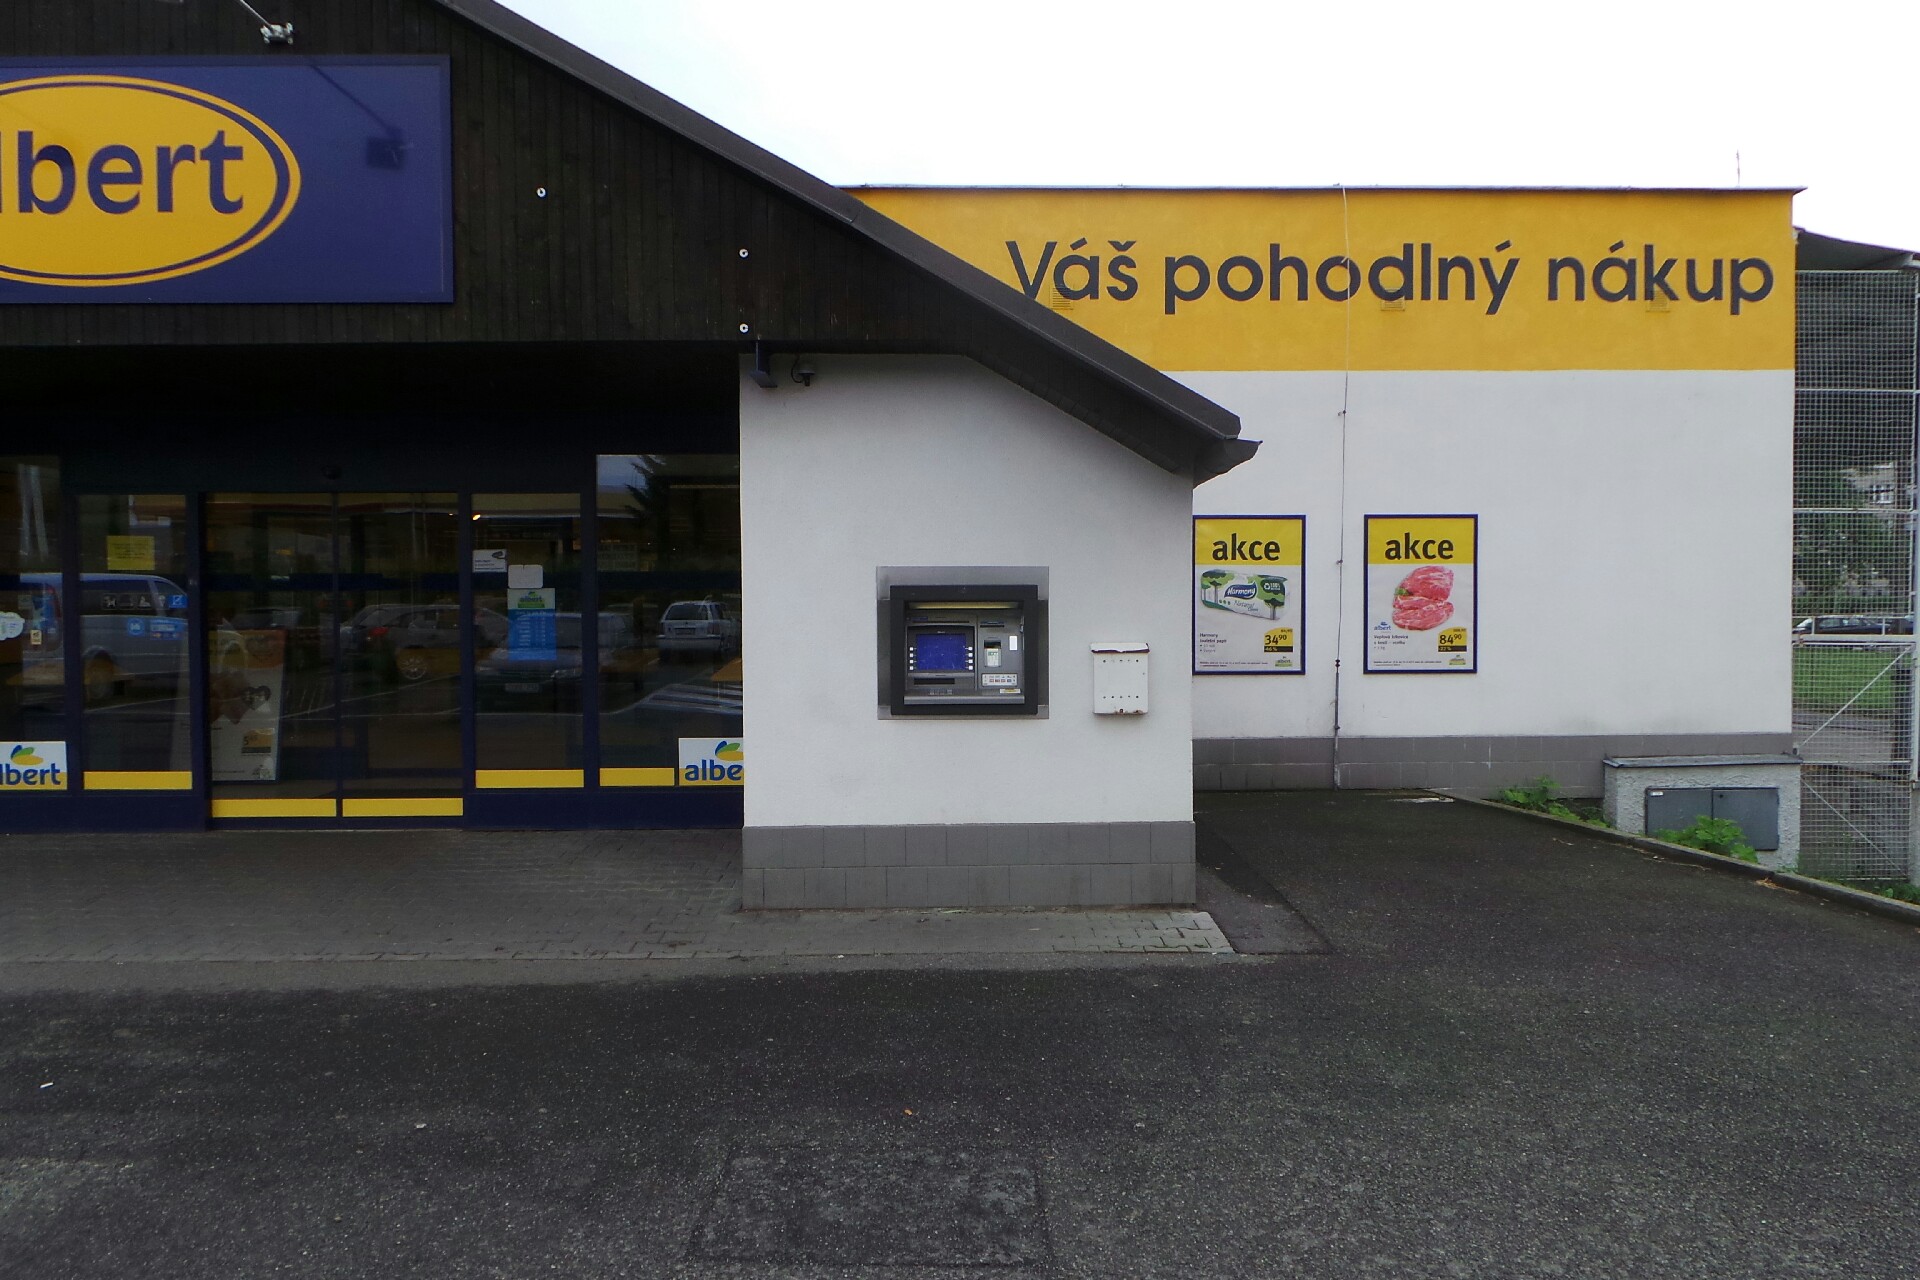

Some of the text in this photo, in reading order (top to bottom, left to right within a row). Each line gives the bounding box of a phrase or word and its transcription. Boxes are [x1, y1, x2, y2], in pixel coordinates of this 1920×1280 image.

[0, 130, 244, 215] bert
[1005, 237, 1774, 316] Váš pohodlný nákup
[1212, 532, 1281, 562] akce
[1384, 531, 1455, 561] akce
[1227, 587, 1256, 597] Harmony
